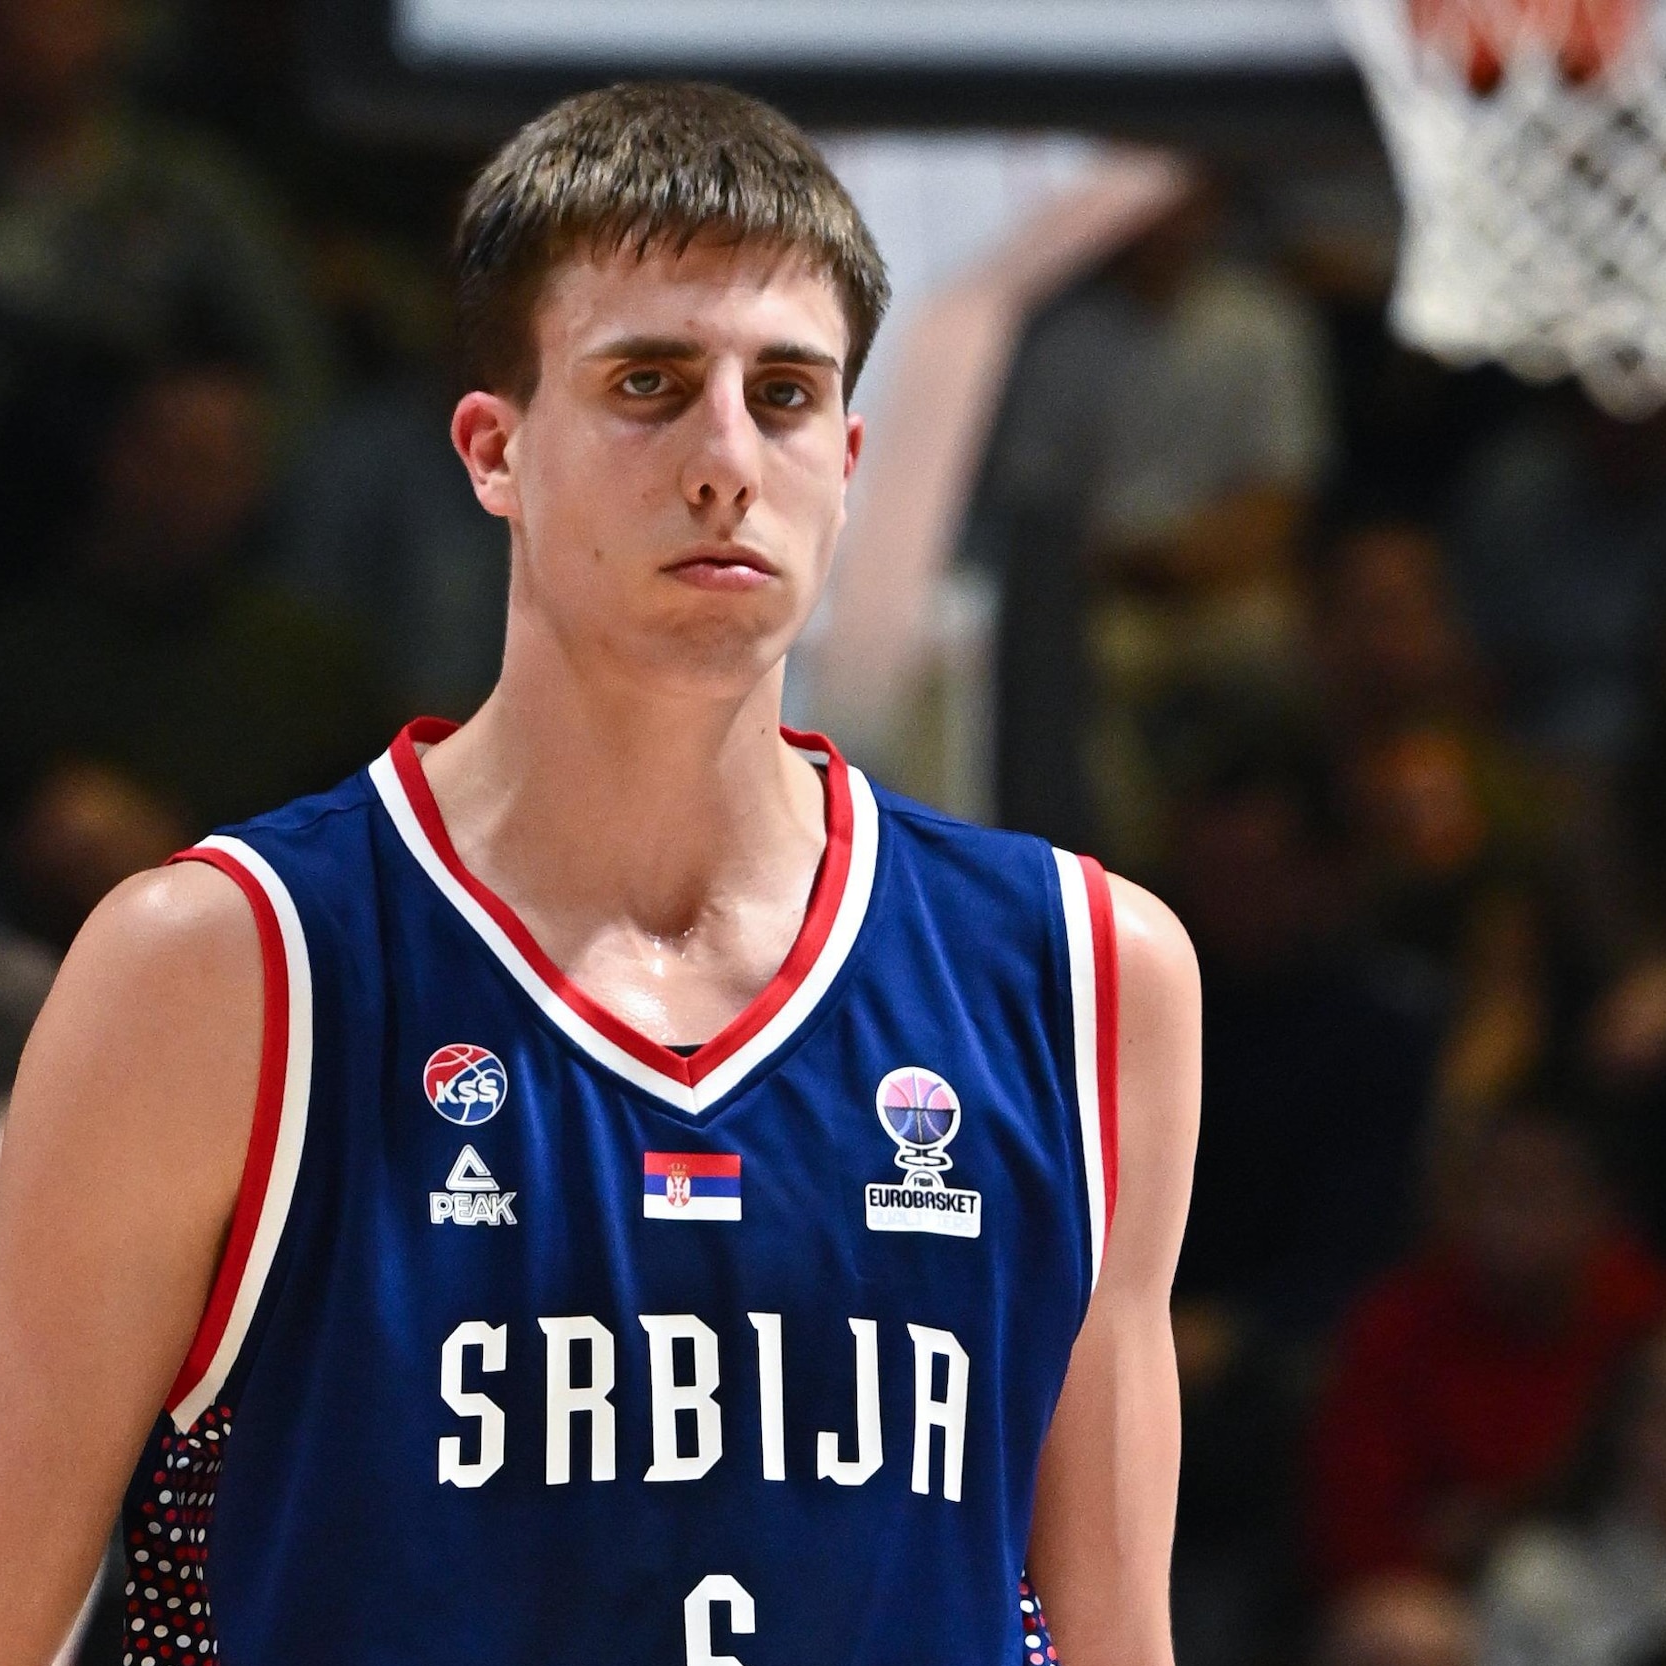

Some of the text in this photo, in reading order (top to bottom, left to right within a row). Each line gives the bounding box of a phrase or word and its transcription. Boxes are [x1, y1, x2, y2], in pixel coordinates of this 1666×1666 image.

[435, 1078, 499, 1104] KSS
[430, 1191, 518, 1226] PEAK
[869, 1187, 977, 1214] EUROBASKET
[438, 1312, 970, 1502] SRBIJA
